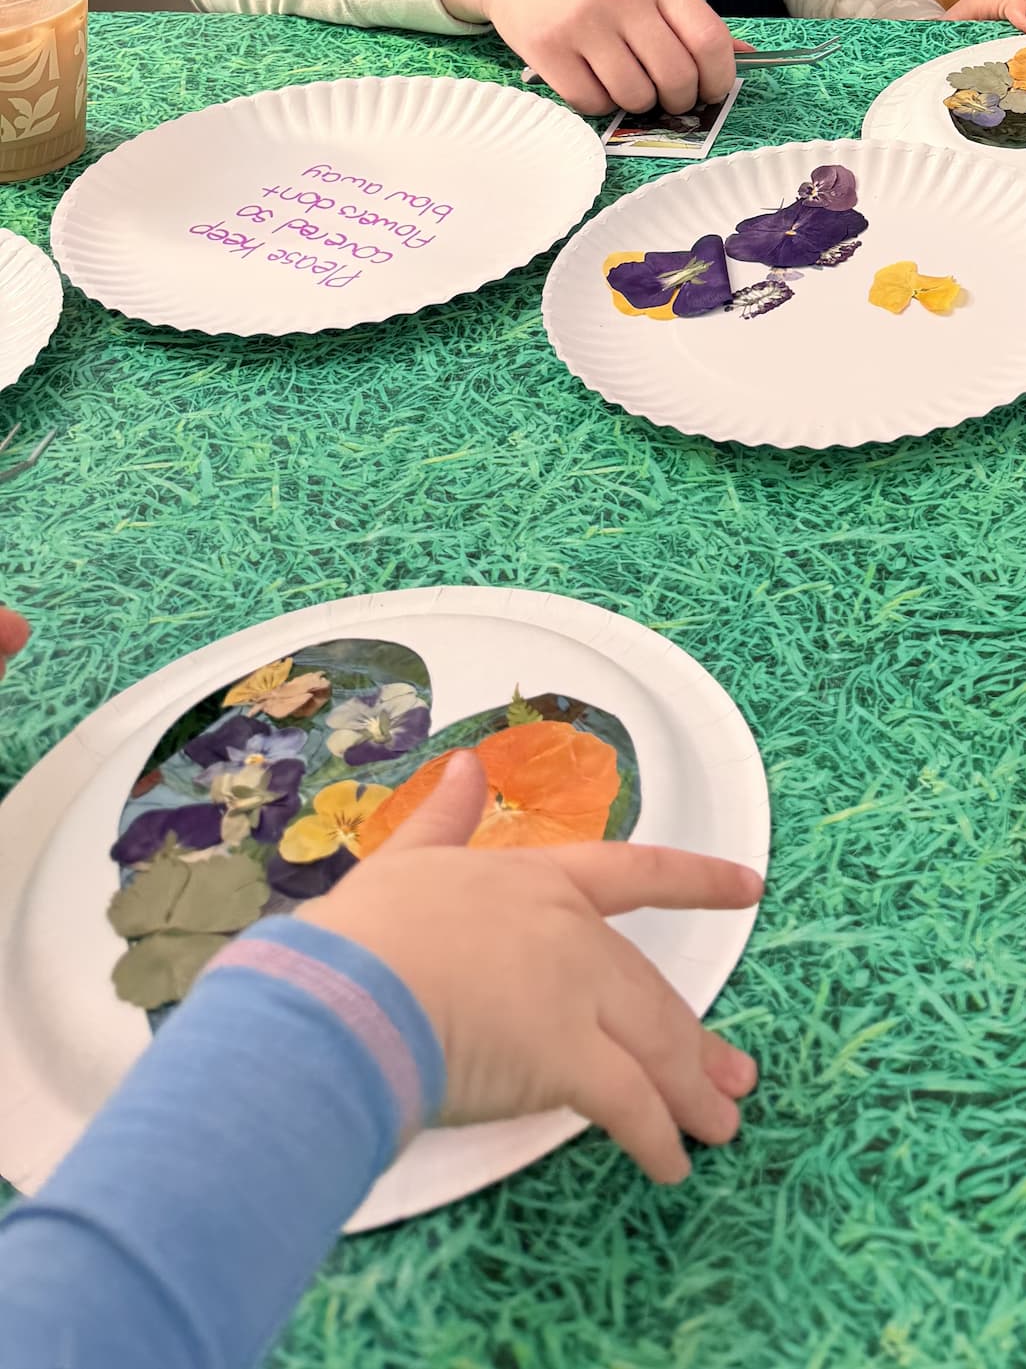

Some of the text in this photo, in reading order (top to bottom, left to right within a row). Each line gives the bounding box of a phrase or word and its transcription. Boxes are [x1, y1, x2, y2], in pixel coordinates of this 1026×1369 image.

[301, 164, 383, 195] away
[236, 205, 393, 263] covered so
[262, 185, 436, 249] flowers dont
[267, 249, 362, 287] Please
